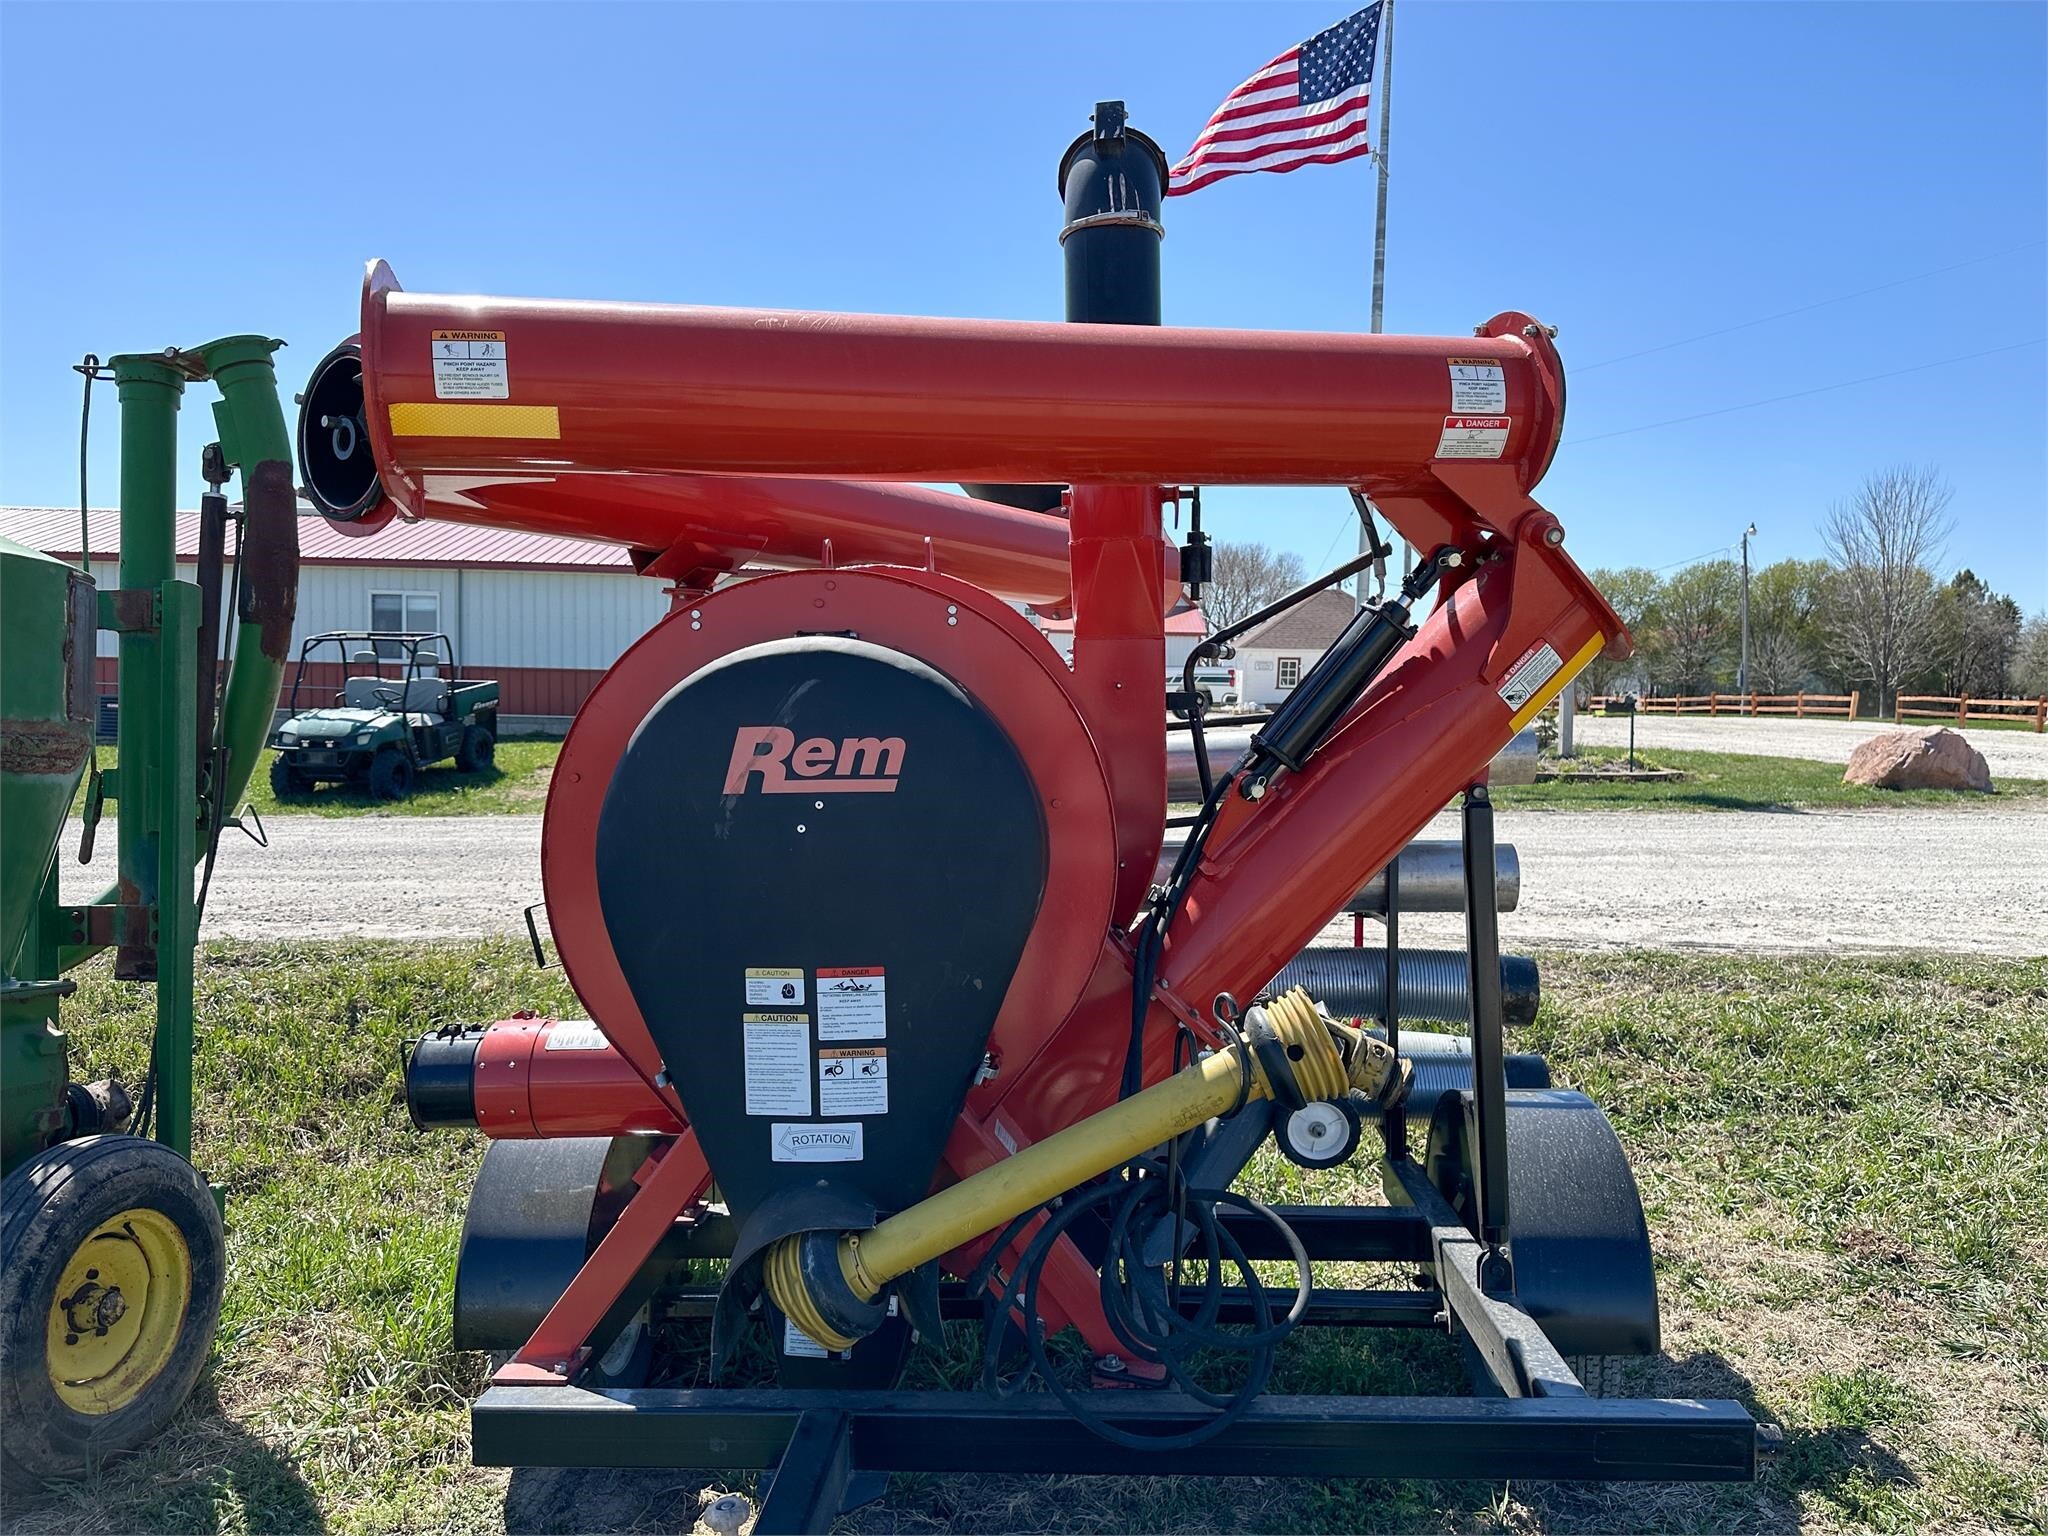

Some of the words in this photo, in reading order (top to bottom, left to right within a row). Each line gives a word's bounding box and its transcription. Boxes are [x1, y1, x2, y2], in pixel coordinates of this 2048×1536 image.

[451, 332, 498, 340] WARNING
[1465, 419, 1500, 427] DANGER
[1509, 648, 1535, 674] DANGER
[722, 726, 906, 795] Rem
[761, 1014, 799, 1022] CAUTION
[839, 1049, 875, 1057] WARNING
[791, 1133, 850, 1146] ROTATION
